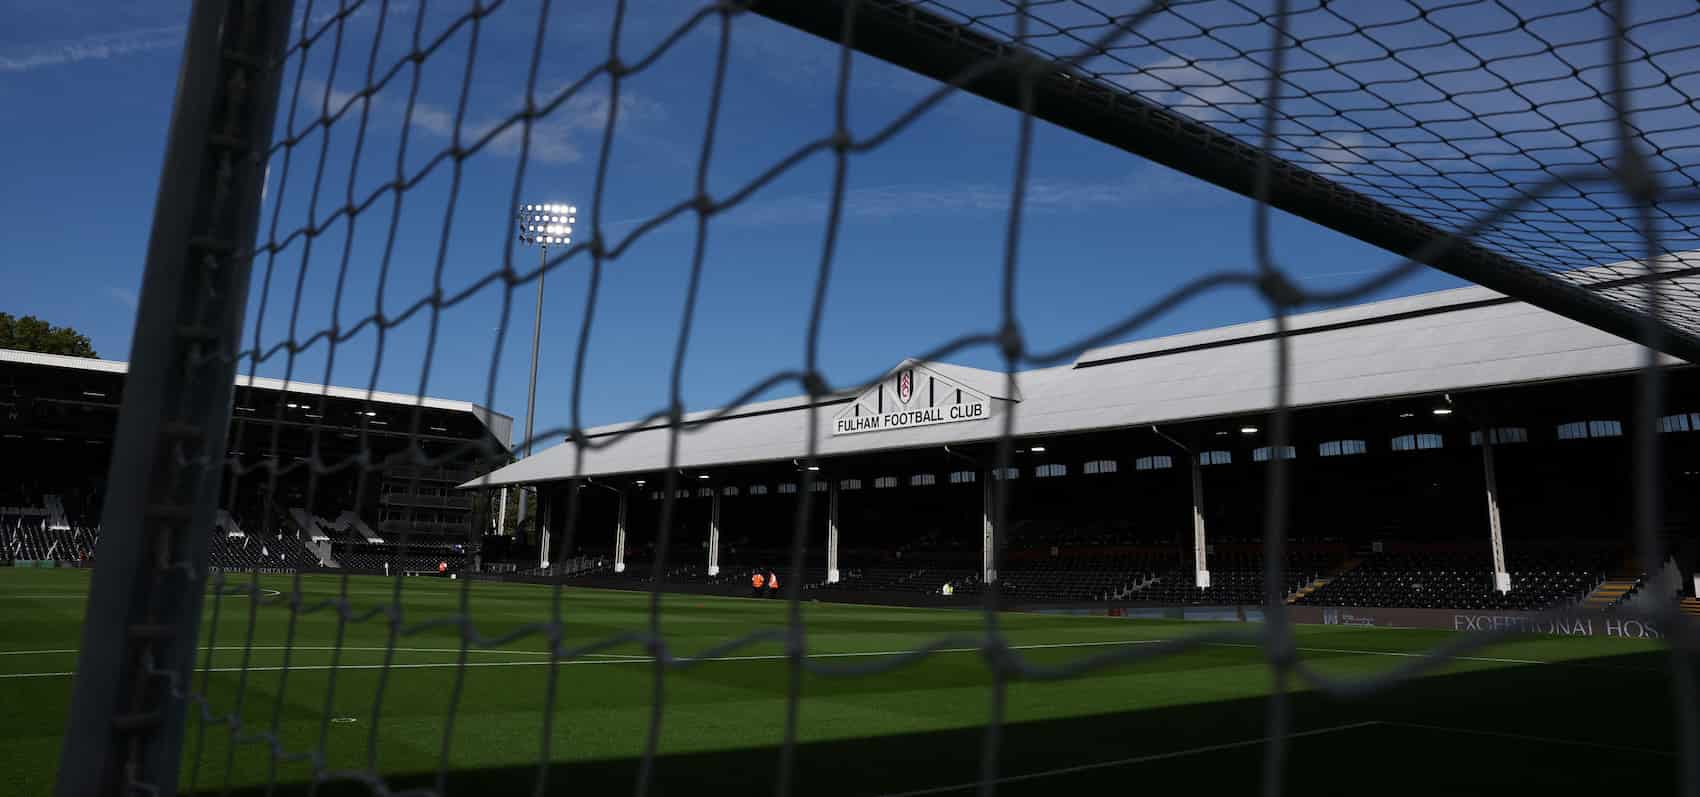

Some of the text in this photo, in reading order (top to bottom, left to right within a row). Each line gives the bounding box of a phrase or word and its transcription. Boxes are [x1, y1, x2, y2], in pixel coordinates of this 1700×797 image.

[838, 403, 983, 433] FULHAM FOOTBALL CLUB
